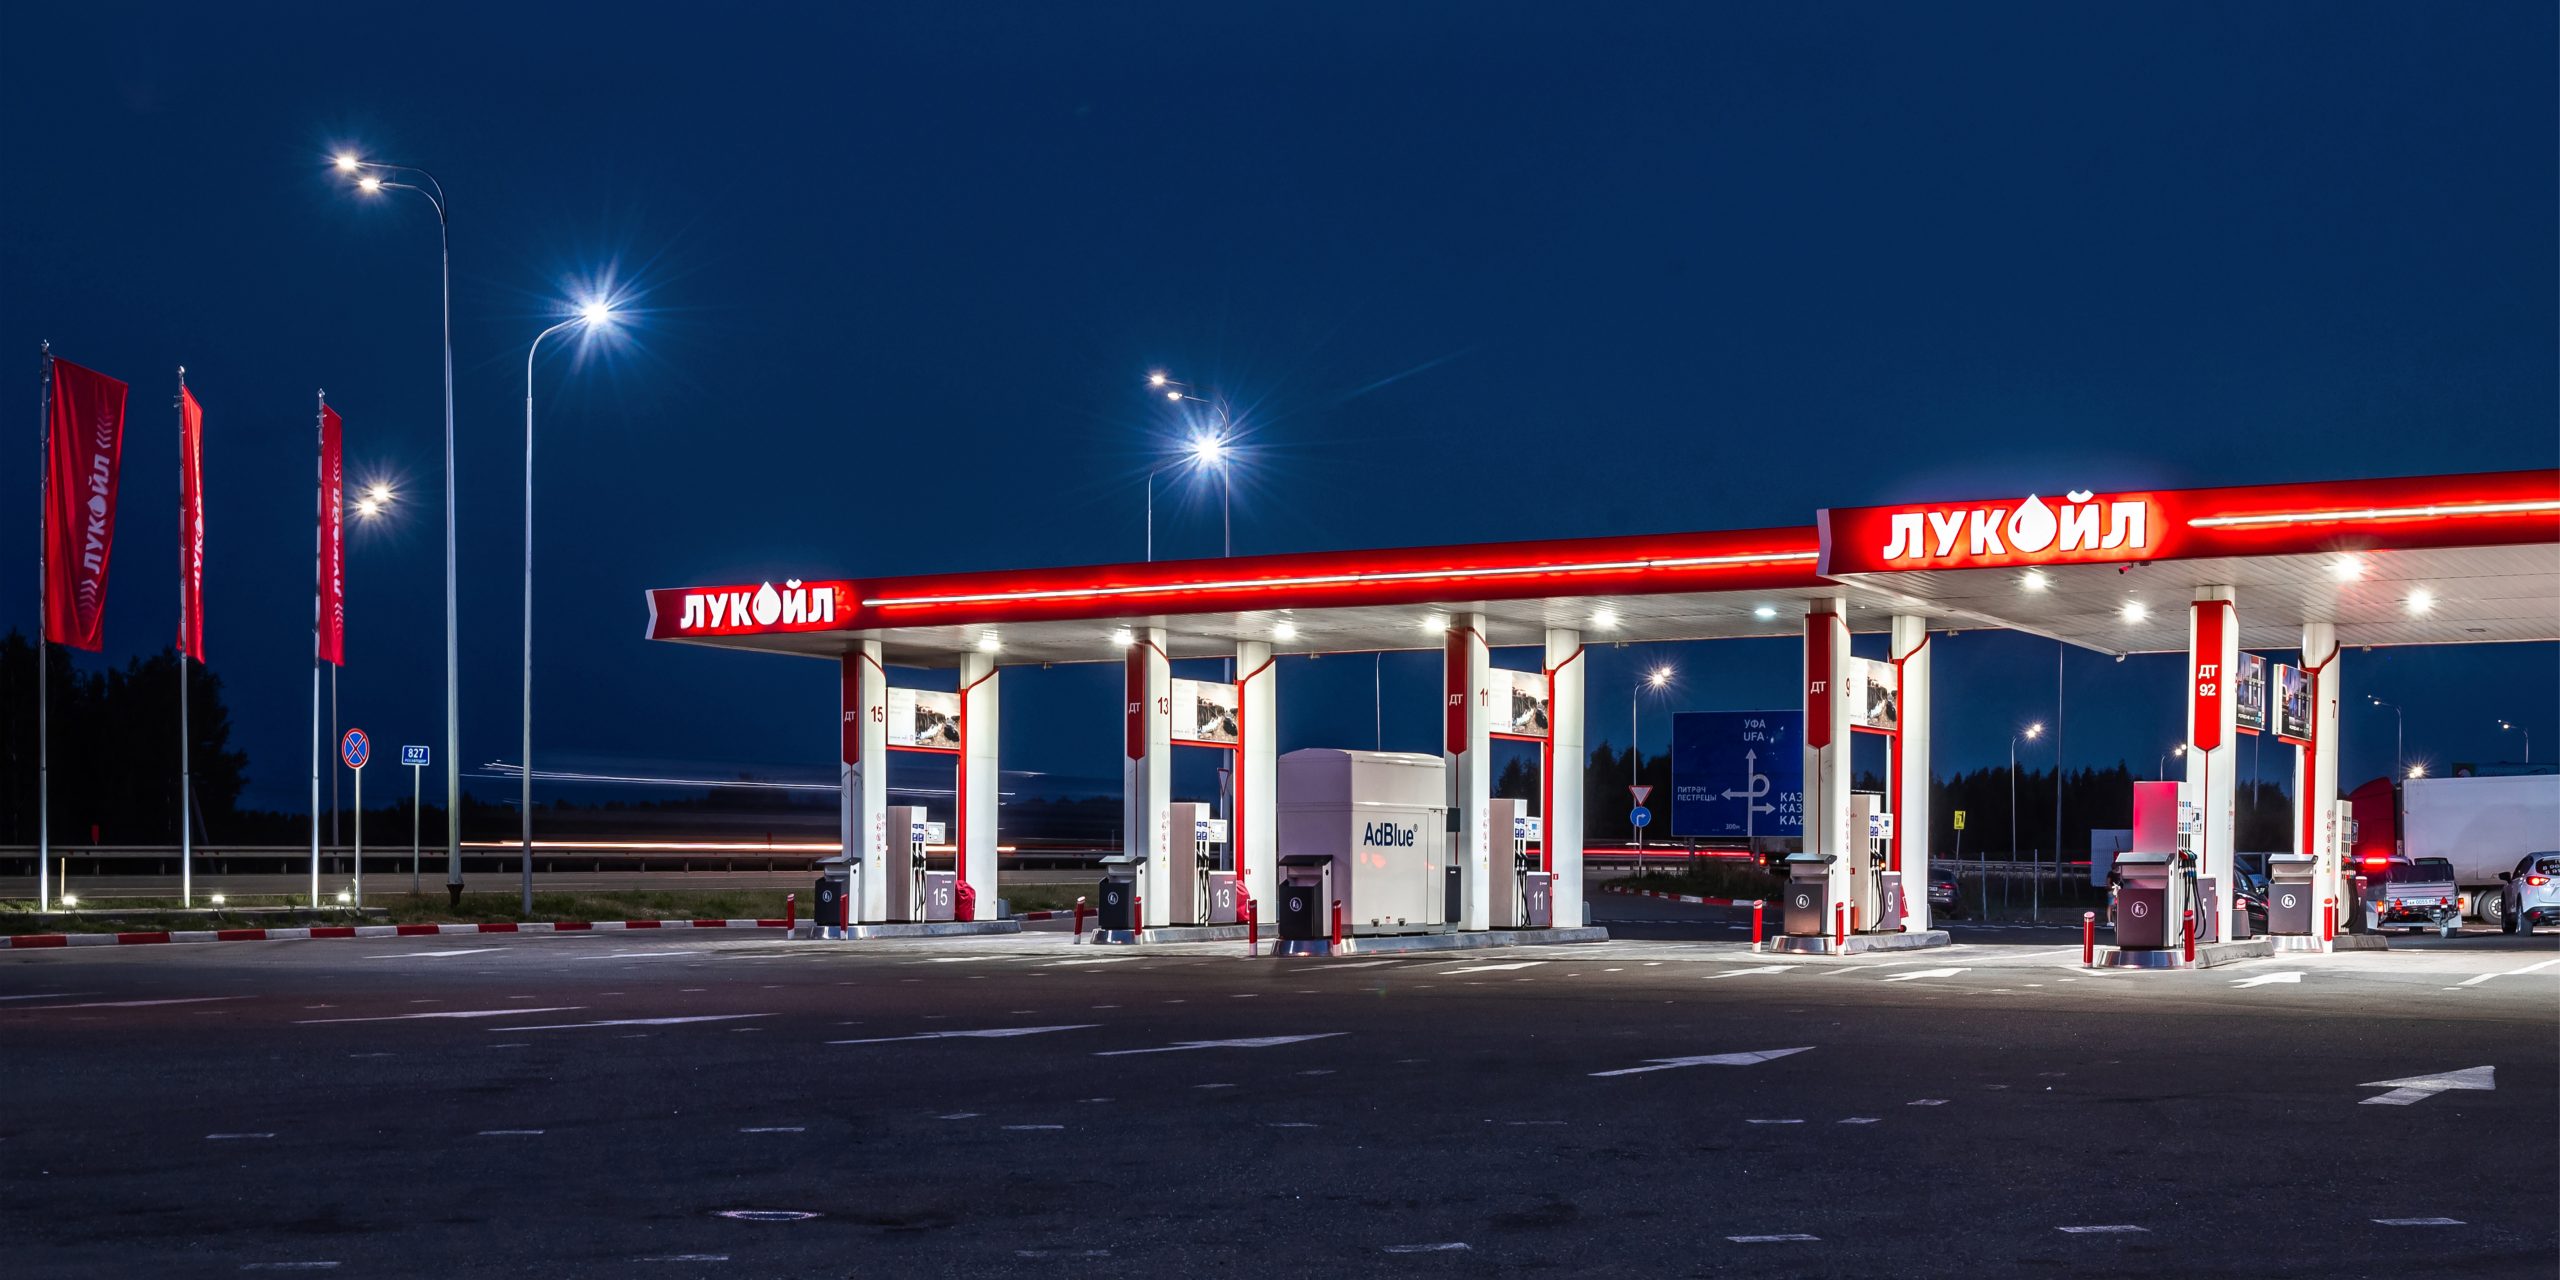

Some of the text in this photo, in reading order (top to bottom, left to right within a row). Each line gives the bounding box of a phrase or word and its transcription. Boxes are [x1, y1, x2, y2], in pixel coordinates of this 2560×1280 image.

[83, 453, 110, 575] ЛУКОЙЛ
[1883, 489, 2147, 560] ЛУКОЙЛ
[680, 578, 834, 629] ЛУКОЙЛ
[2198, 664, 2219, 680] ДТ
[1810, 680, 1827, 695] ДТ
[2199, 683, 2217, 697] 92
[1157, 696, 1169, 716] 13
[1448, 693, 1464, 707] ДТ
[1479, 687, 1489, 707] 11
[844, 711, 856, 722] ДТ
[870, 705, 884, 723] 15
[1128, 702, 1142, 715] ДТ
[2331, 699, 2337, 719] 7
[1744, 719, 1767, 729] УФА
[1743, 731, 1765, 742] UFA
[408, 748, 424, 759] 827
[1677, 793, 1717, 802] ПЕСТРЕЦЫ
[933, 887, 948, 906] 15
[1215, 889, 1230, 908] 13
[1533, 890, 1544, 910] 11
[1887, 891, 1894, 913] 9
